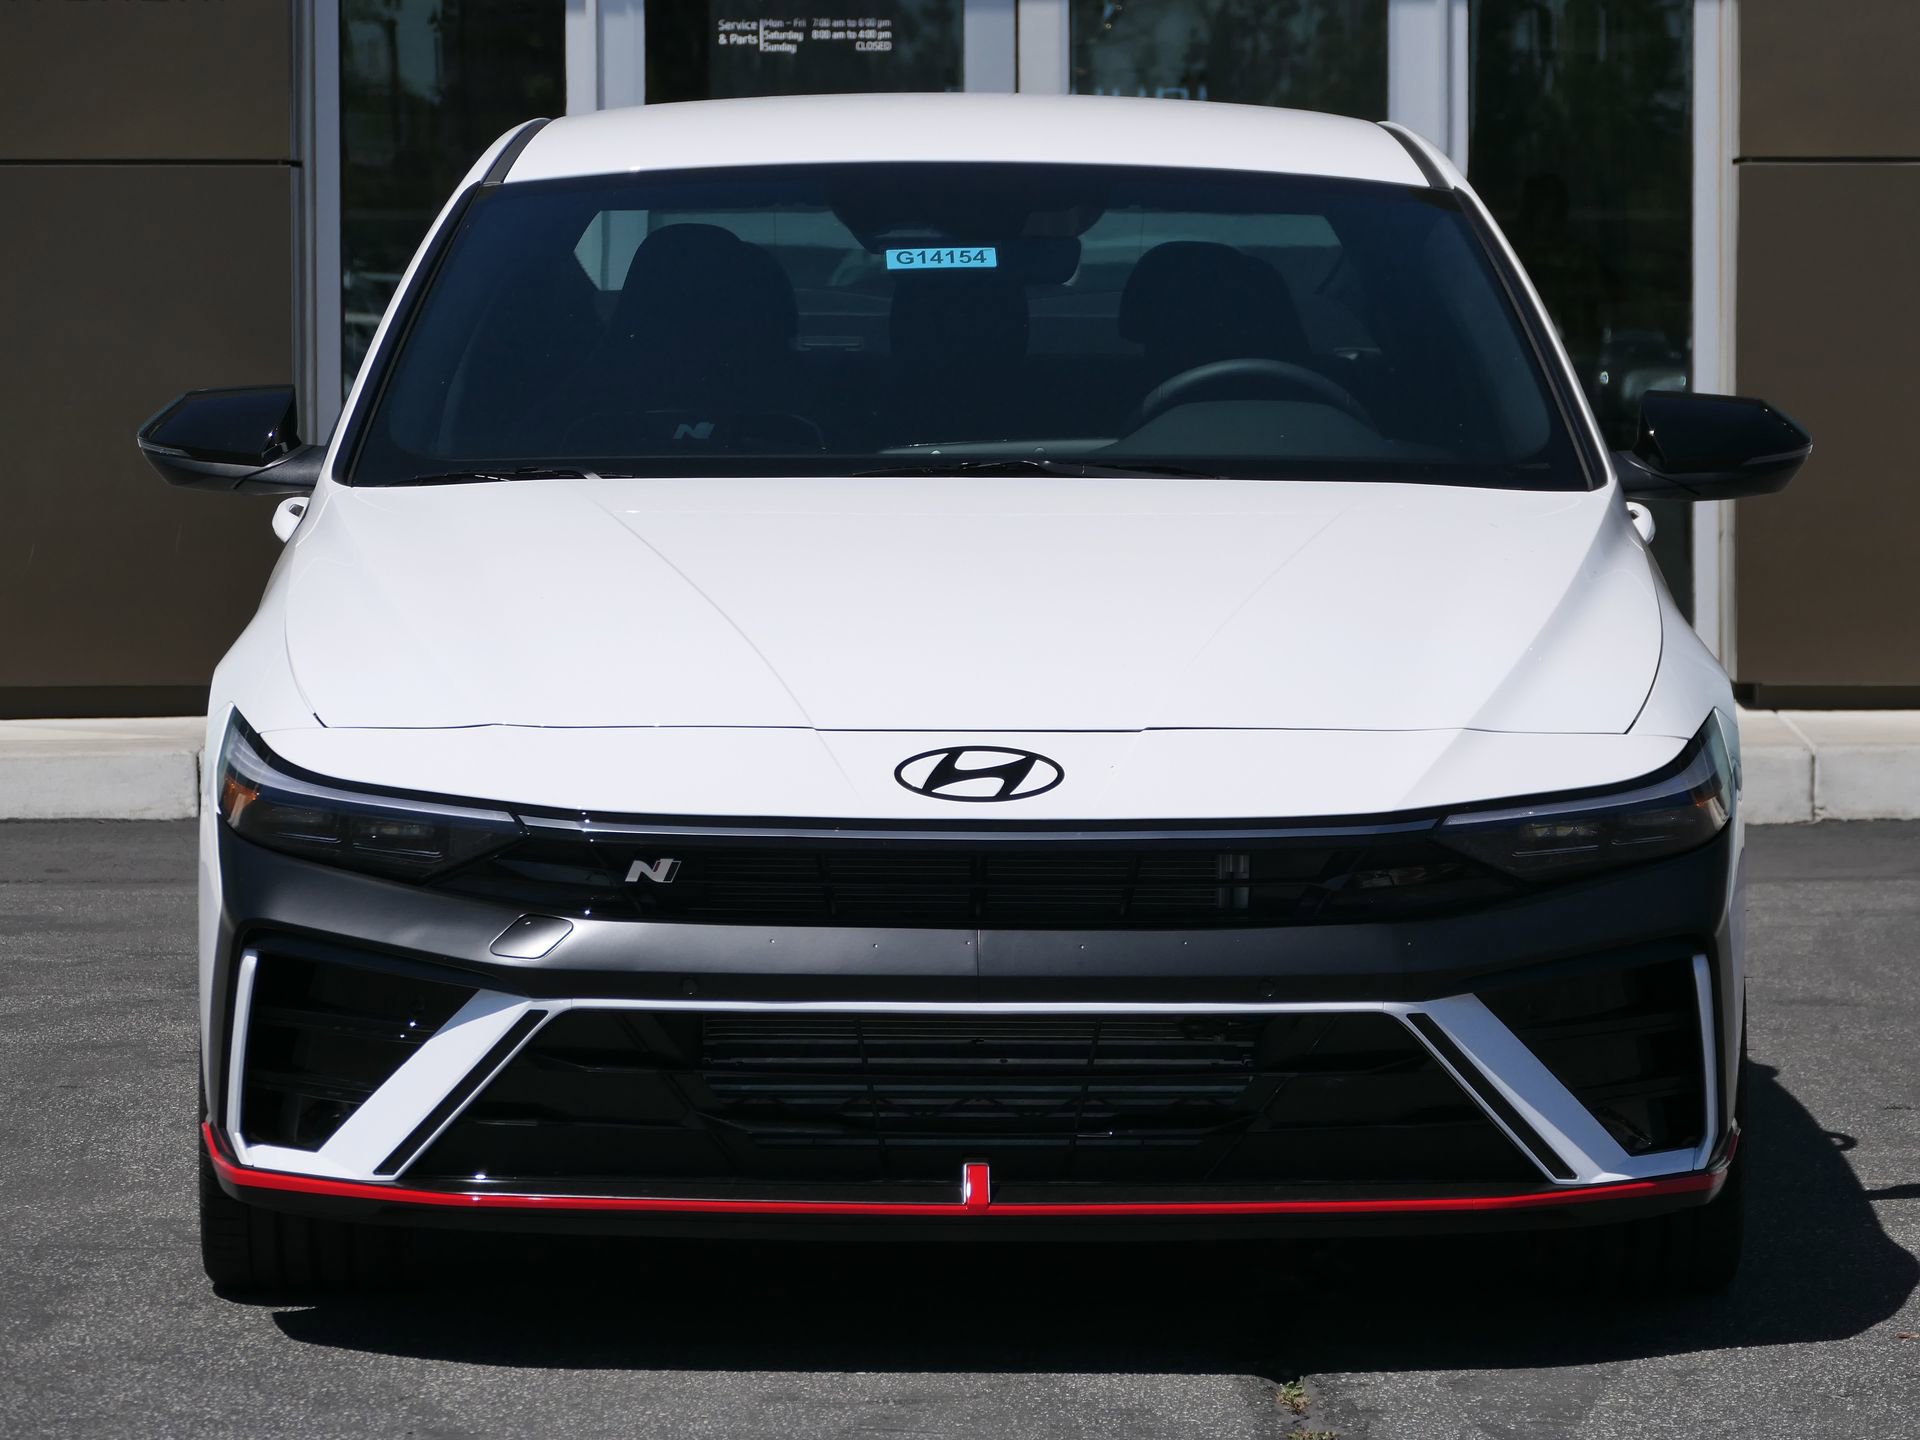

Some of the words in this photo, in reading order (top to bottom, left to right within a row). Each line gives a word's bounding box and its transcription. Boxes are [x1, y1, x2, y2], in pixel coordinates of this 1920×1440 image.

[718, 19, 758, 31] Service
[764, 19, 784, 28] Mon
[793, 18, 807, 28] Fri
[832, 20, 846, 28] am
[846, 19, 857, 28] to
[877, 19, 892, 29] pm
[718, 33, 728, 45] &
[729, 33, 758, 45] Parts
[764, 29, 804, 42] Saturday
[832, 31, 846, 40] am
[846, 30, 857, 40] to
[877, 31, 892, 41] pm
[764, 42, 798, 55] Sunday
[855, 41, 892, 51] CLOSED
[895, 249, 988, 265] G14154
